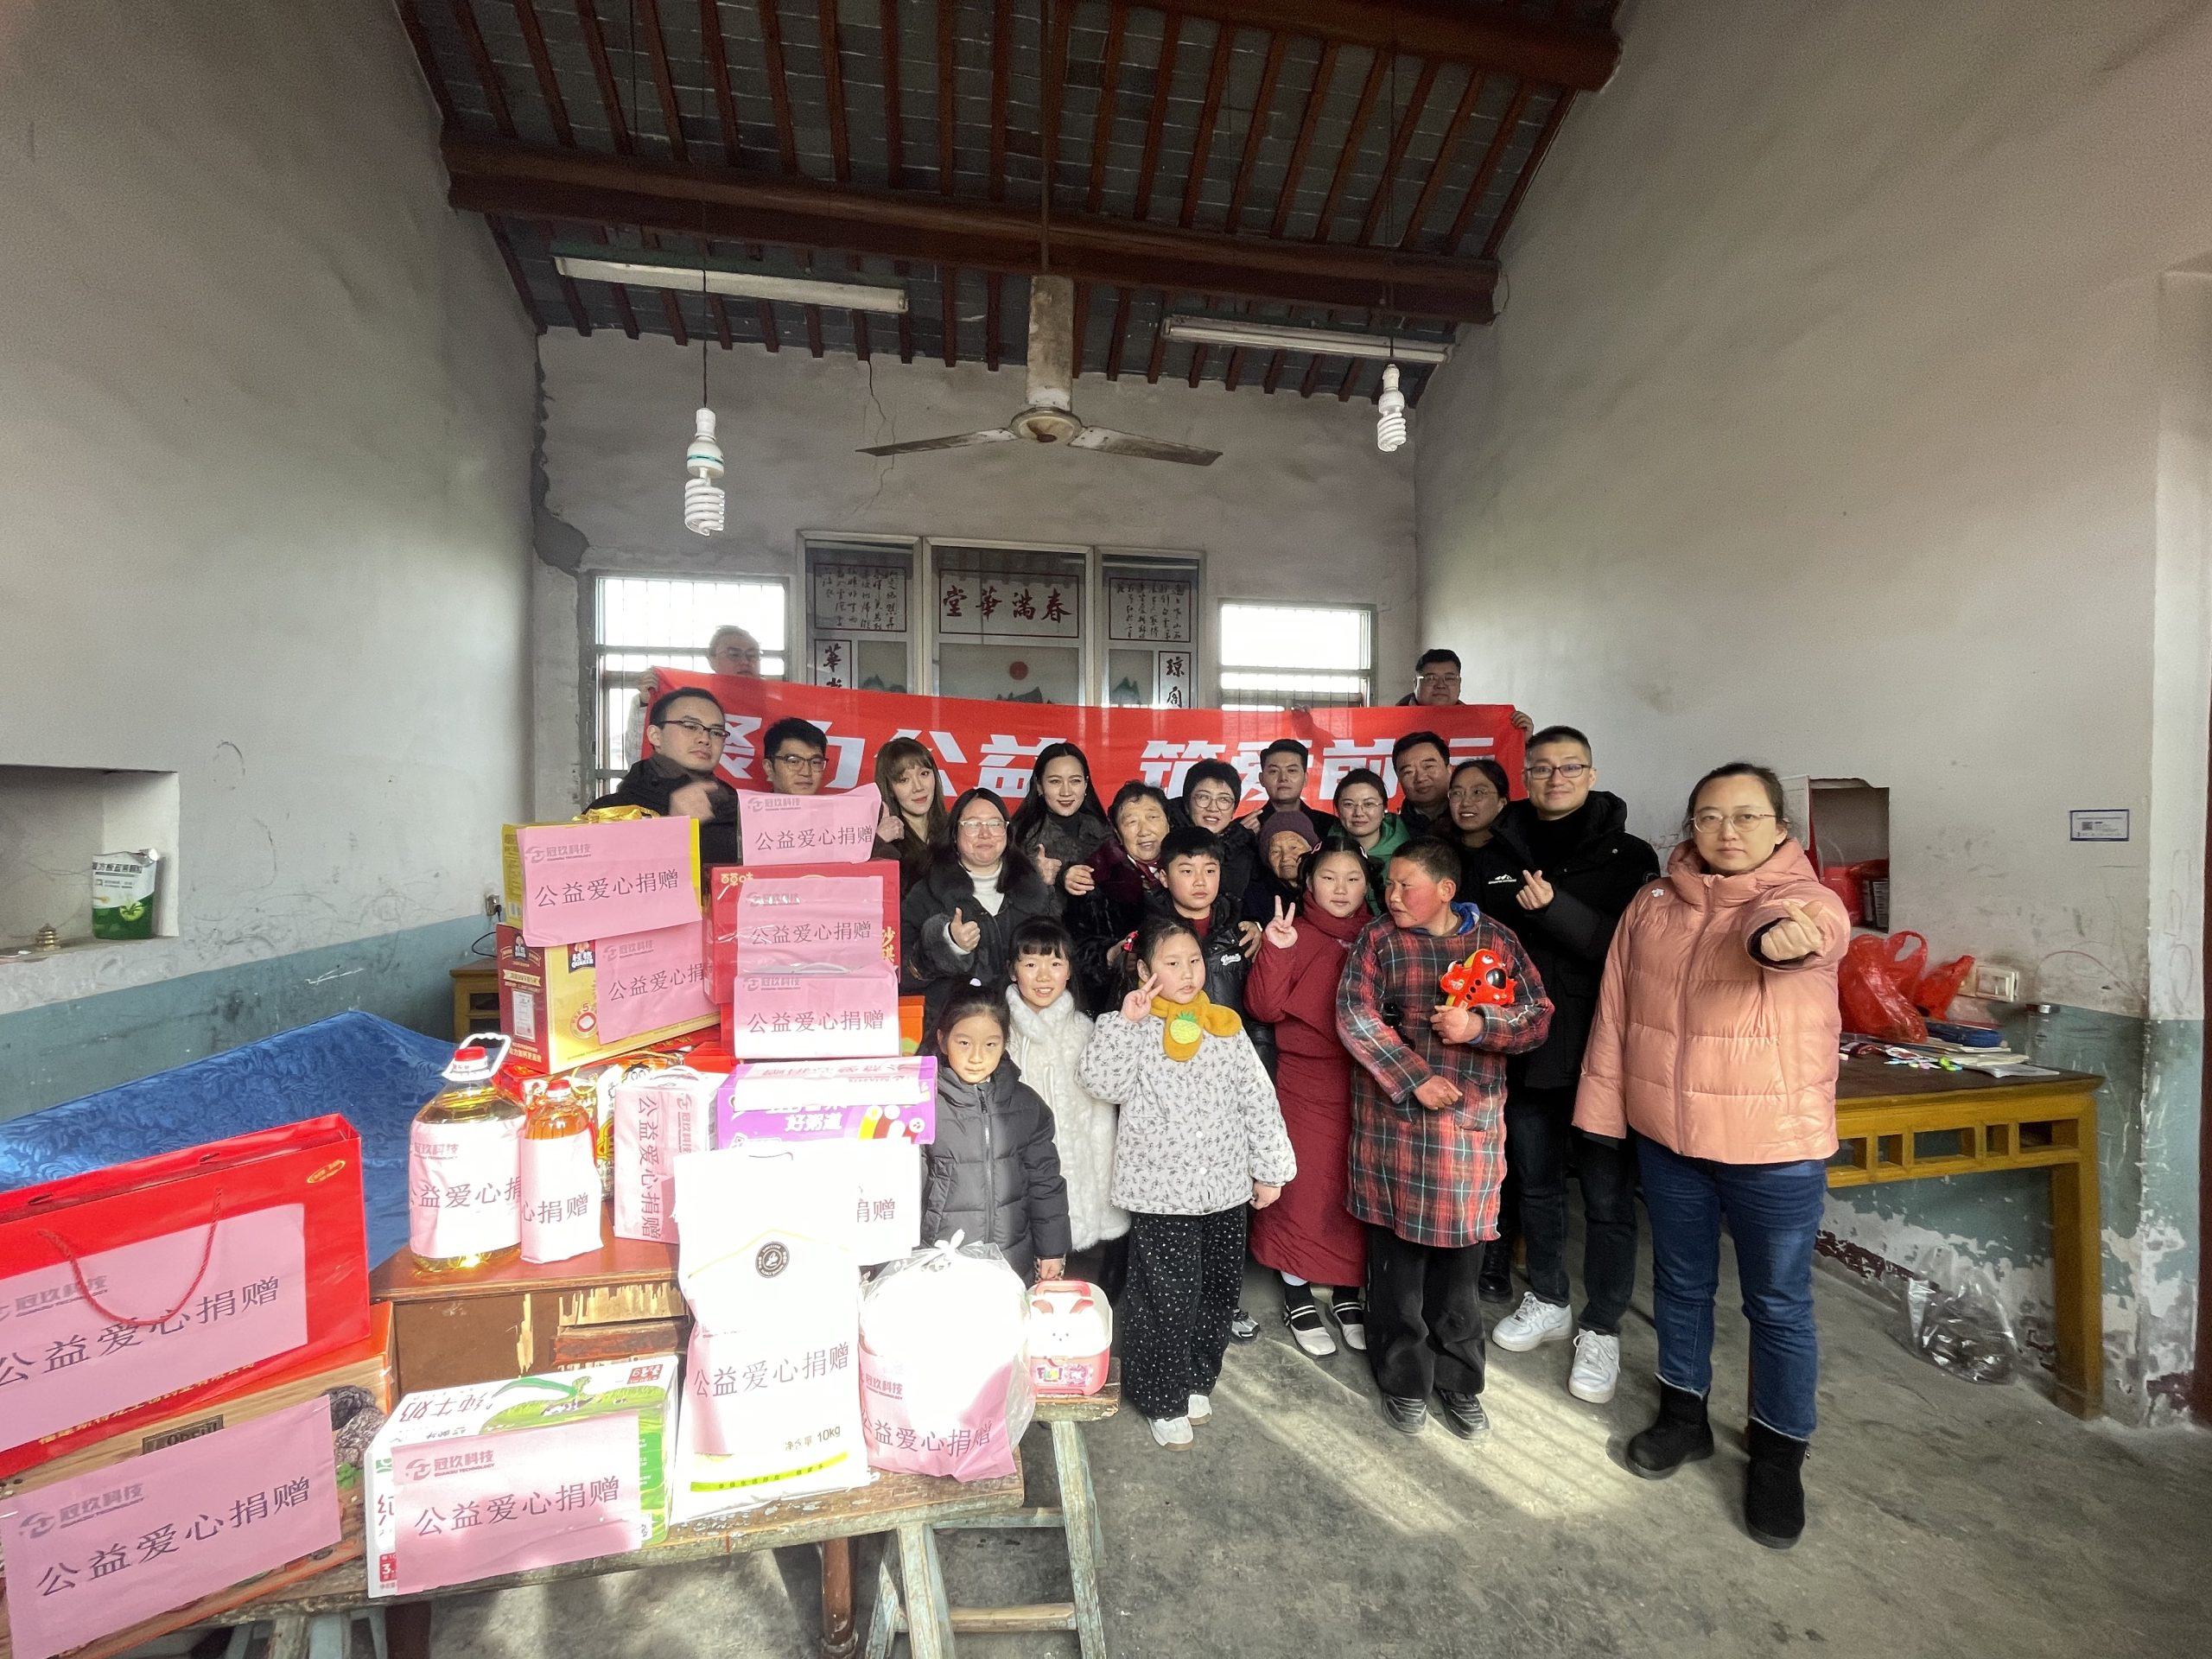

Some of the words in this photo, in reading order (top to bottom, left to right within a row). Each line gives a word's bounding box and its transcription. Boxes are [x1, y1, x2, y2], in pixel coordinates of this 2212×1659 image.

[1140, 737, 1497, 801] 筑爱前
[546, 843, 593, 857] 冠玖科技
[754, 824, 873, 851] 公益爱心捐赠
[534, 868, 678, 908] 公益爱心捐赠
[751, 920, 872, 946] 公益爱心捐赠
[747, 1009, 885, 1034] 公益爱心捐赠
[639, 1096, 663, 1240] 公益爱心捐赠
[0, 1275, 280, 1387] 公益爱心捐赠
[693, 1341, 849, 1399] 公益爱心捐赠
[817, 1426, 841, 1443] 10kg
[434, 1450, 494, 1471] 冠玖科技
[59, 1482, 144, 1522] 冠玖科技
[414, 1475, 620, 1538] 公益爱心捐赠
[36, 1476, 311, 1598] 公益爱心捐赠
